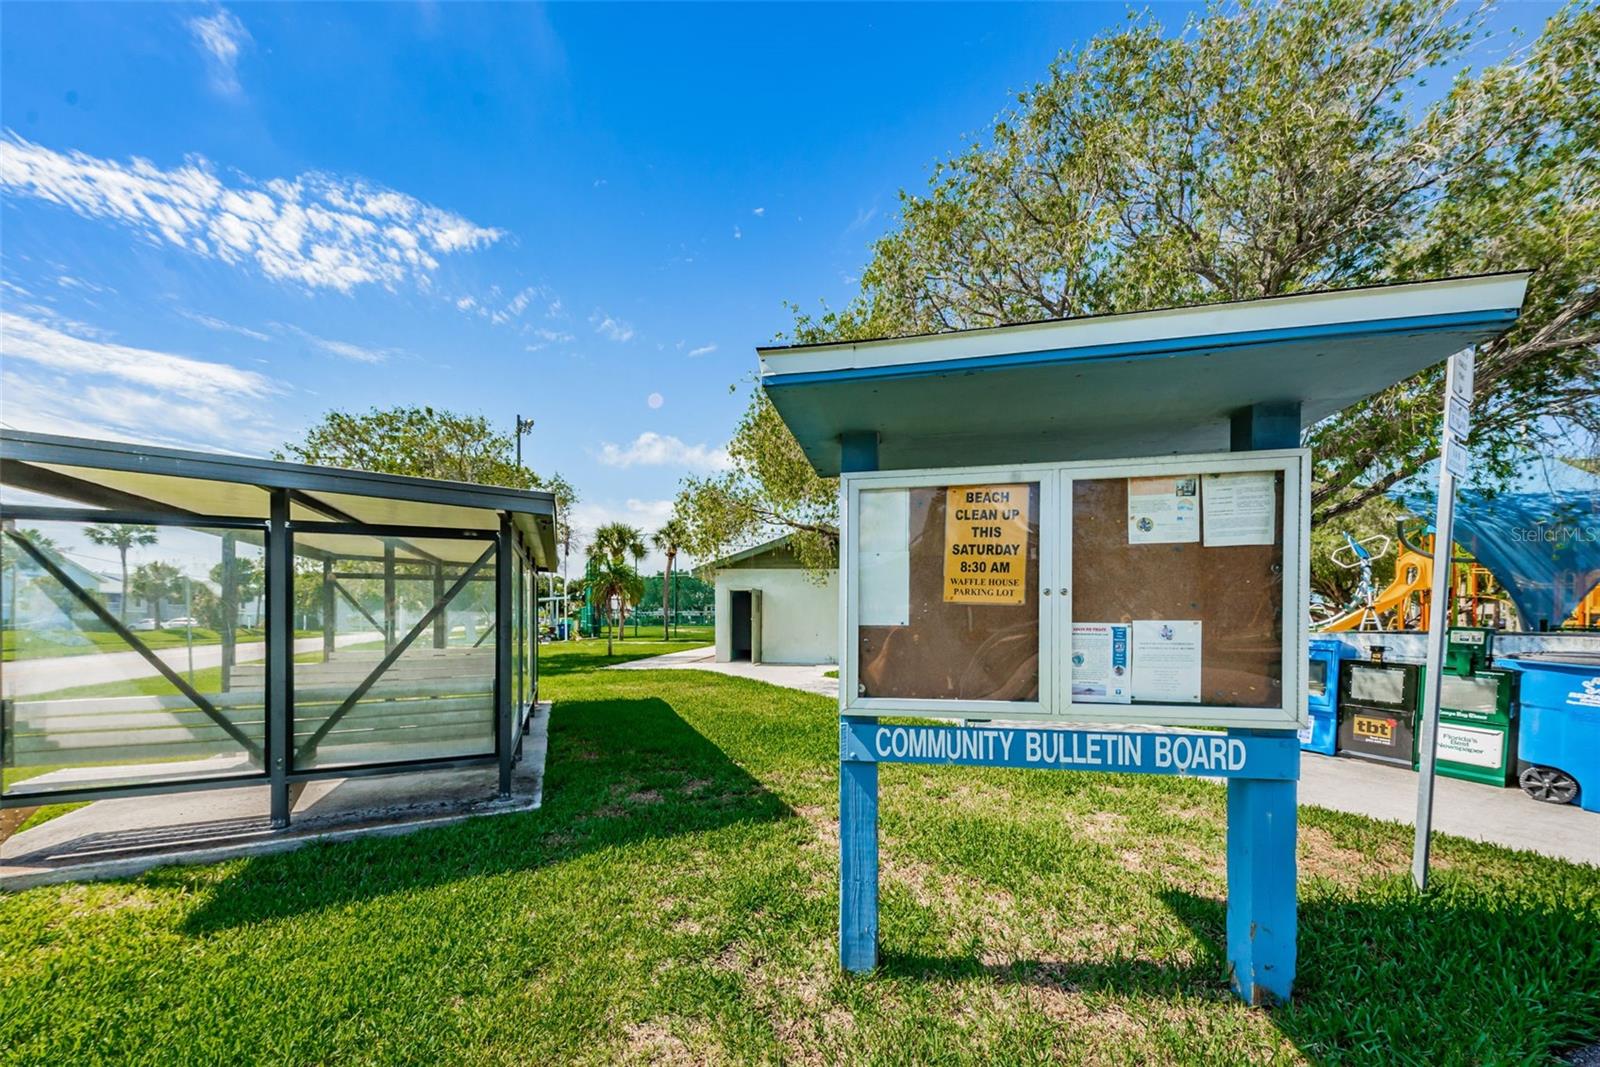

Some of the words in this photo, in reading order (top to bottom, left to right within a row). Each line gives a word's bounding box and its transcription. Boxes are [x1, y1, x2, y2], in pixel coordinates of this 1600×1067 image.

[966, 492, 1010, 503] BEACH
[955, 509, 998, 521] CLEAN
[1002, 509, 1020, 521] UP
[971, 526, 1002, 538] THIS
[952, 544, 1020, 555] SATURDAY
[960, 561, 987, 573] 8:30
[990, 562, 1010, 573] AM
[950, 578, 987, 586] WAFFLE
[988, 578, 1020, 587] HOUSE
[953, 588, 994, 597] PARKING
[996, 588, 1015, 597] LOT
[1357, 719, 1389, 736] tbt
[1443, 733, 1478, 744] Florida's
[875, 727, 1014, 761] COMMUNITY
[1026, 732, 1142, 766] BULLETIN
[1155, 736, 1247, 771] BOARD
